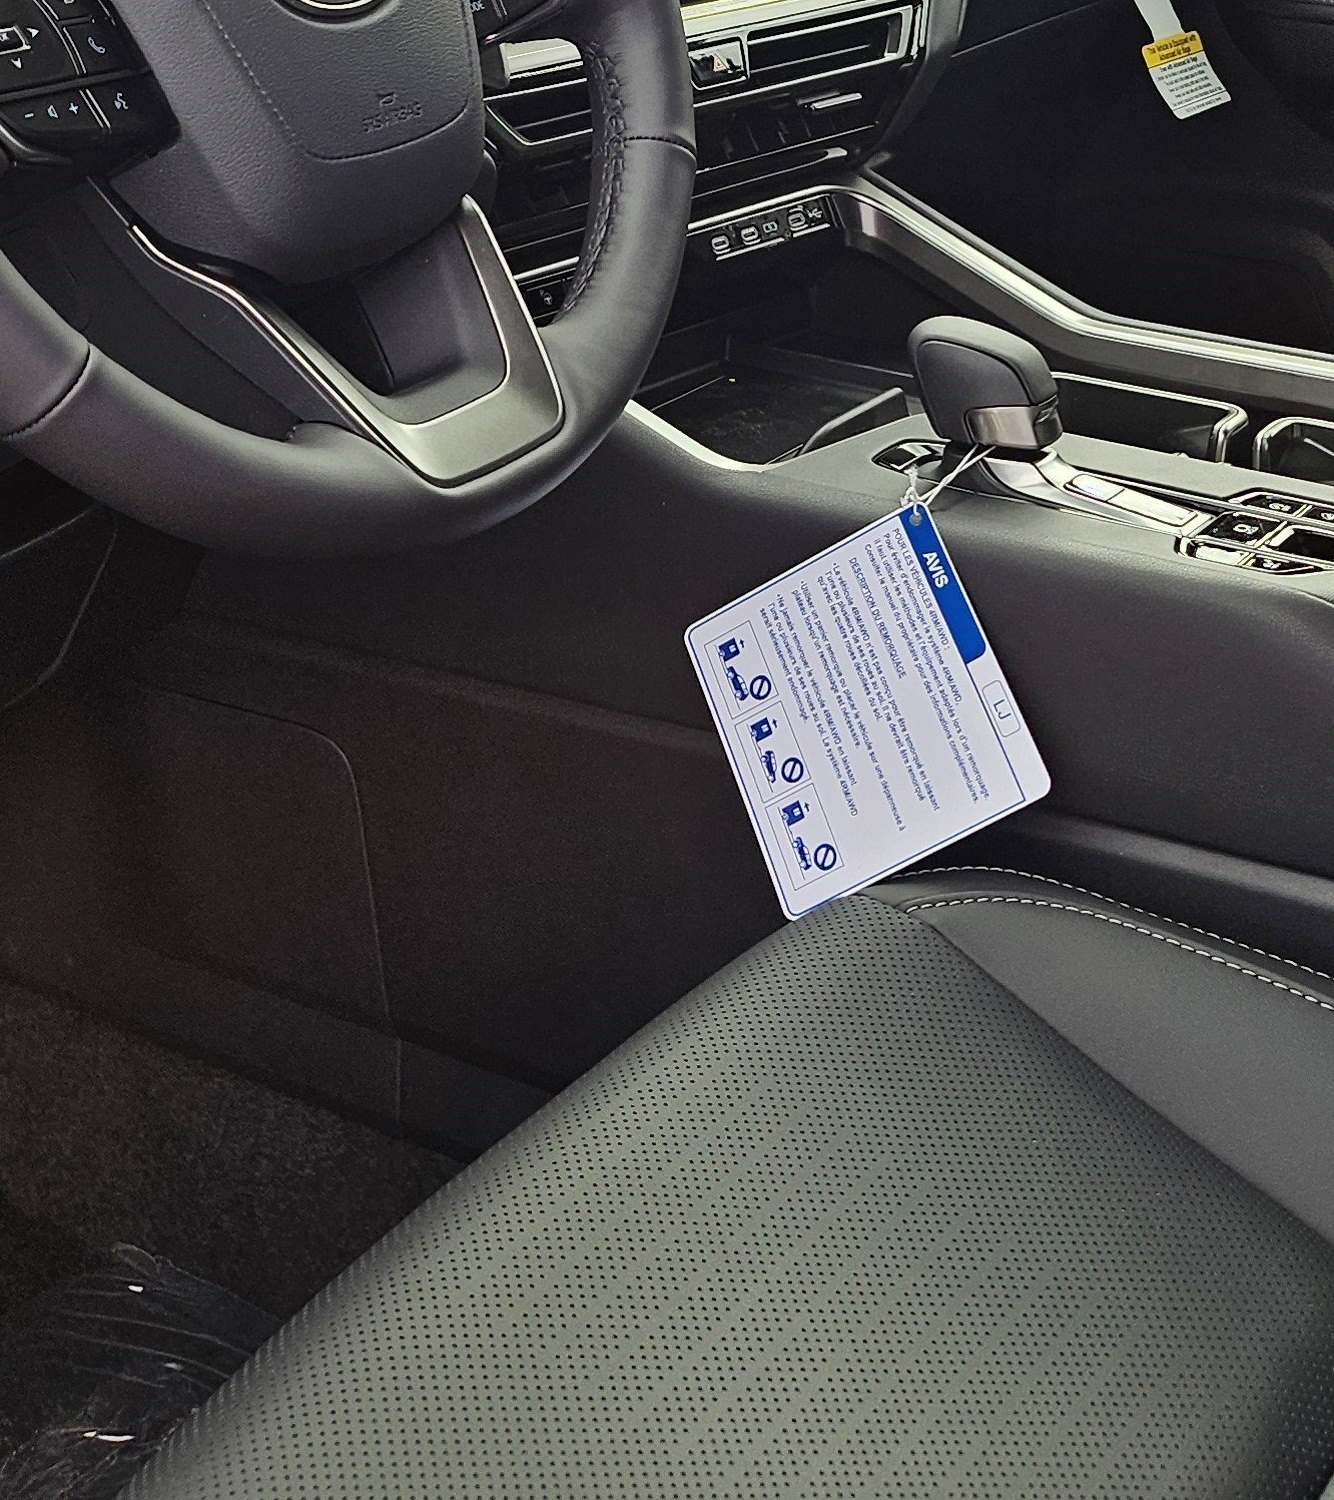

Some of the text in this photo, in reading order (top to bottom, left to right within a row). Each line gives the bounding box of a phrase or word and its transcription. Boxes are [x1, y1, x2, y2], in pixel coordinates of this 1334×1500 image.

[470, 0, 486, 12] ODE
[891, 526, 907, 551] POUR
[922, 549, 950, 590] AVIS
[992, 699, 1007, 721] LJ
